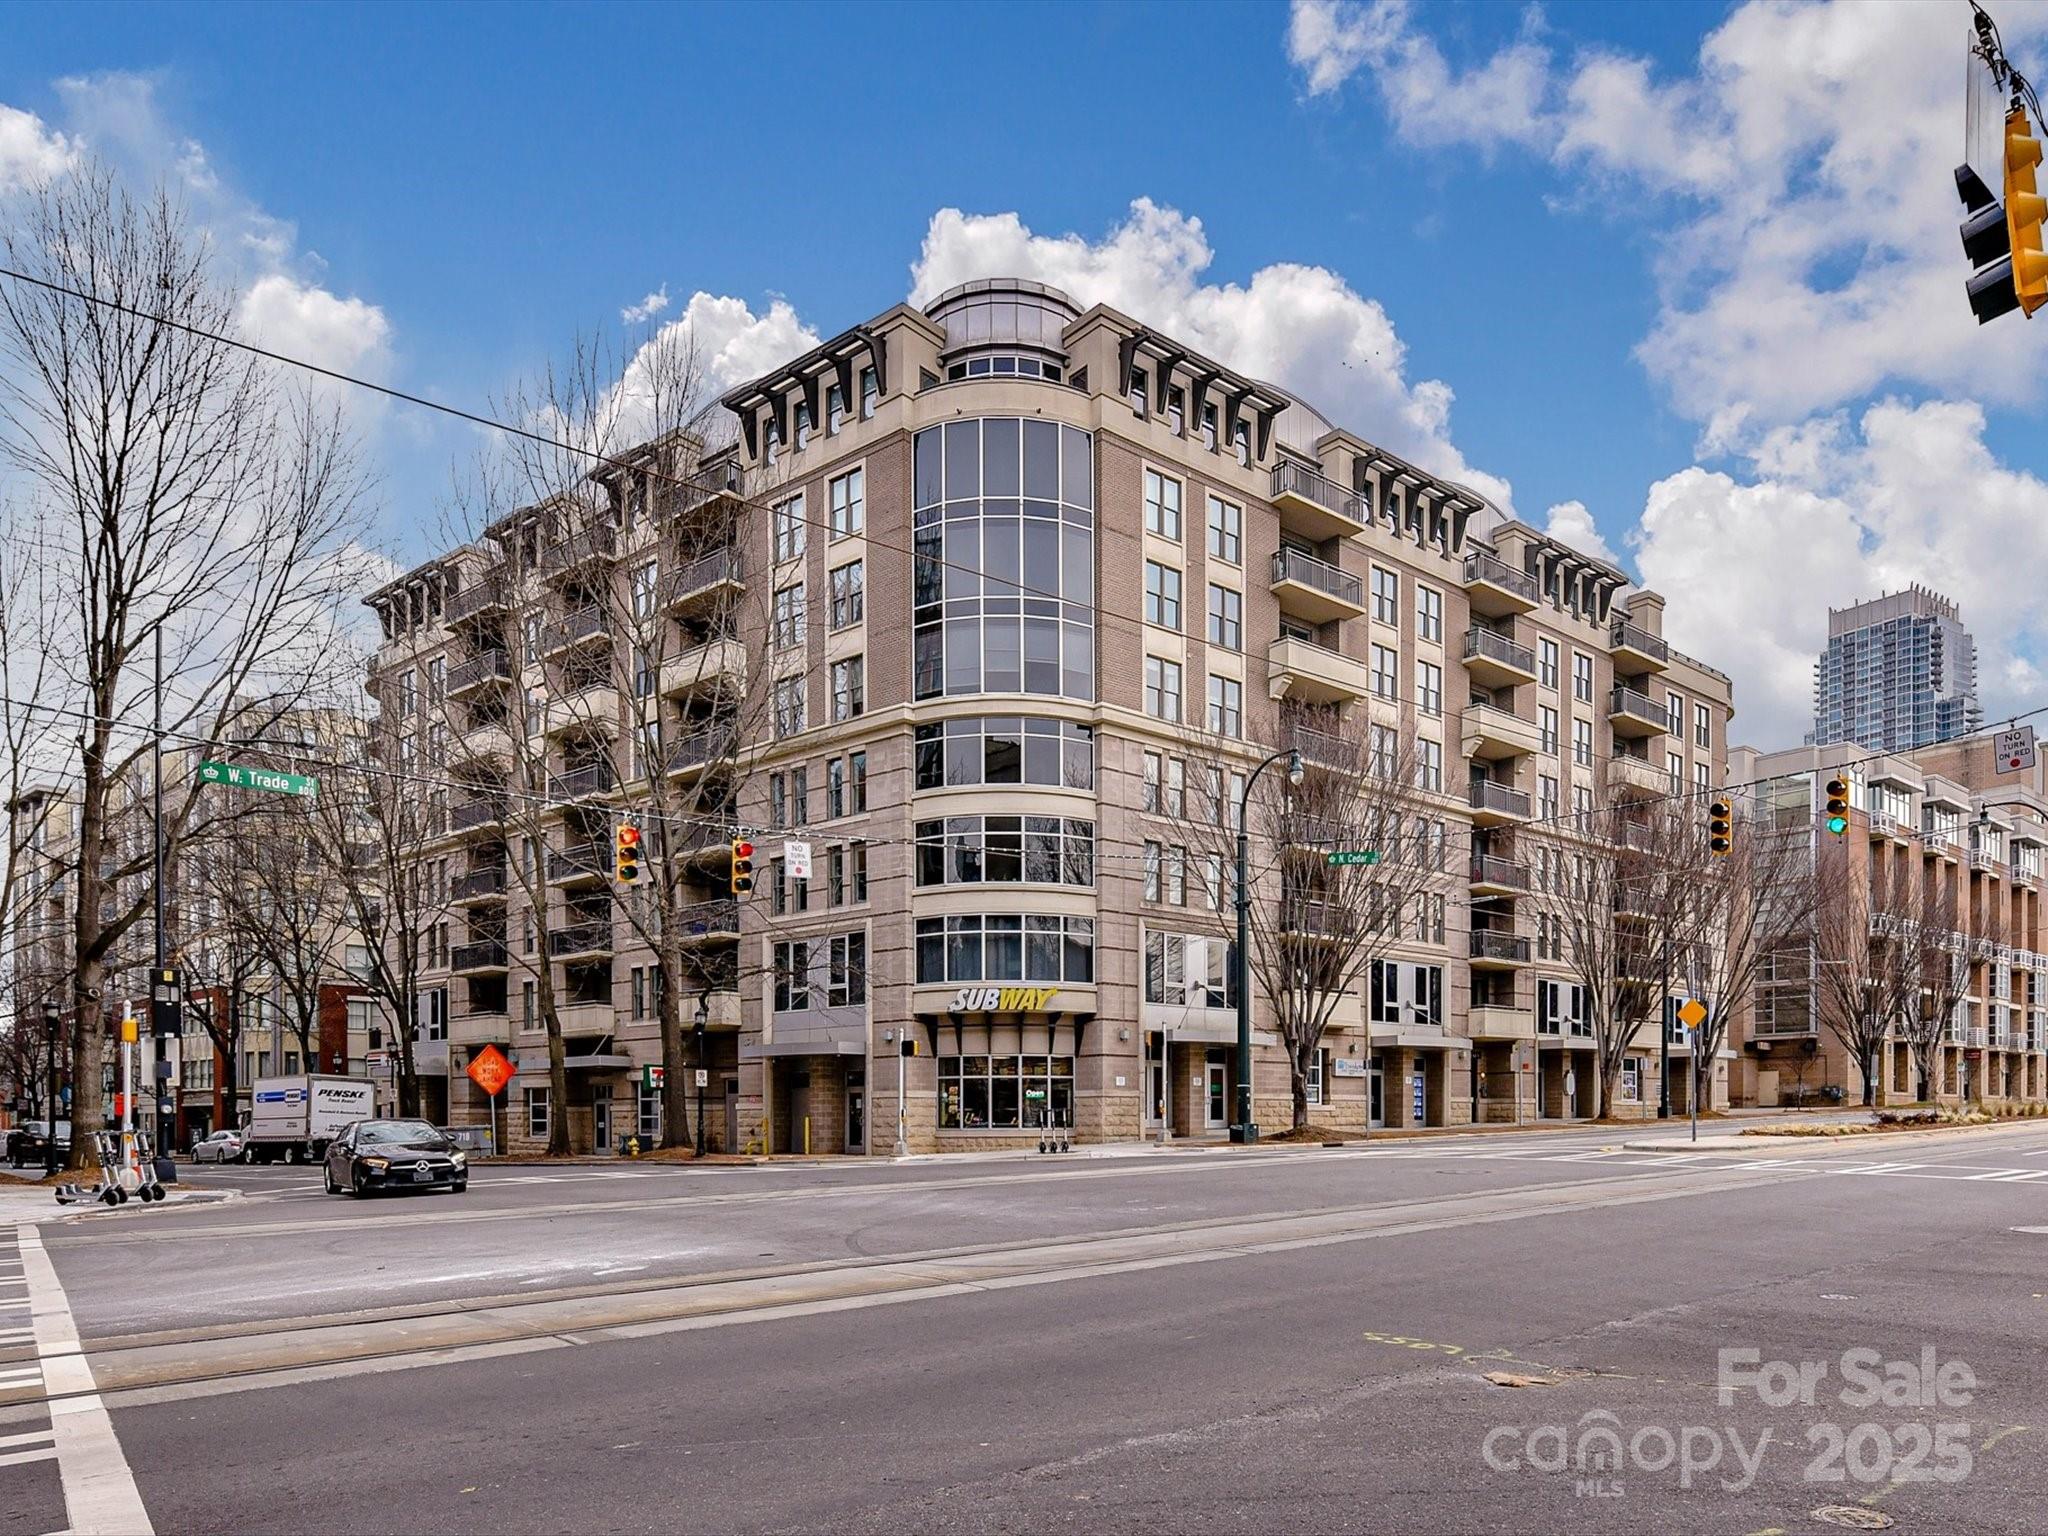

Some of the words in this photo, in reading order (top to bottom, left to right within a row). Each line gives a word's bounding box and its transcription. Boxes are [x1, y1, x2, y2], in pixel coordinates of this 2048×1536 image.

[2005, 732, 2021, 742] NO
[2003, 741, 2025, 751] TURN
[1999, 753, 2010, 761] ON
[2014, 748, 2030, 757] RED
[249, 771, 289, 789] Trade
[792, 844, 803, 852] NO
[1348, 853, 1368, 863] Cedar
[949, 986, 1058, 1013] SUBWAY
[318, 1089, 367, 1099] PENSKE
